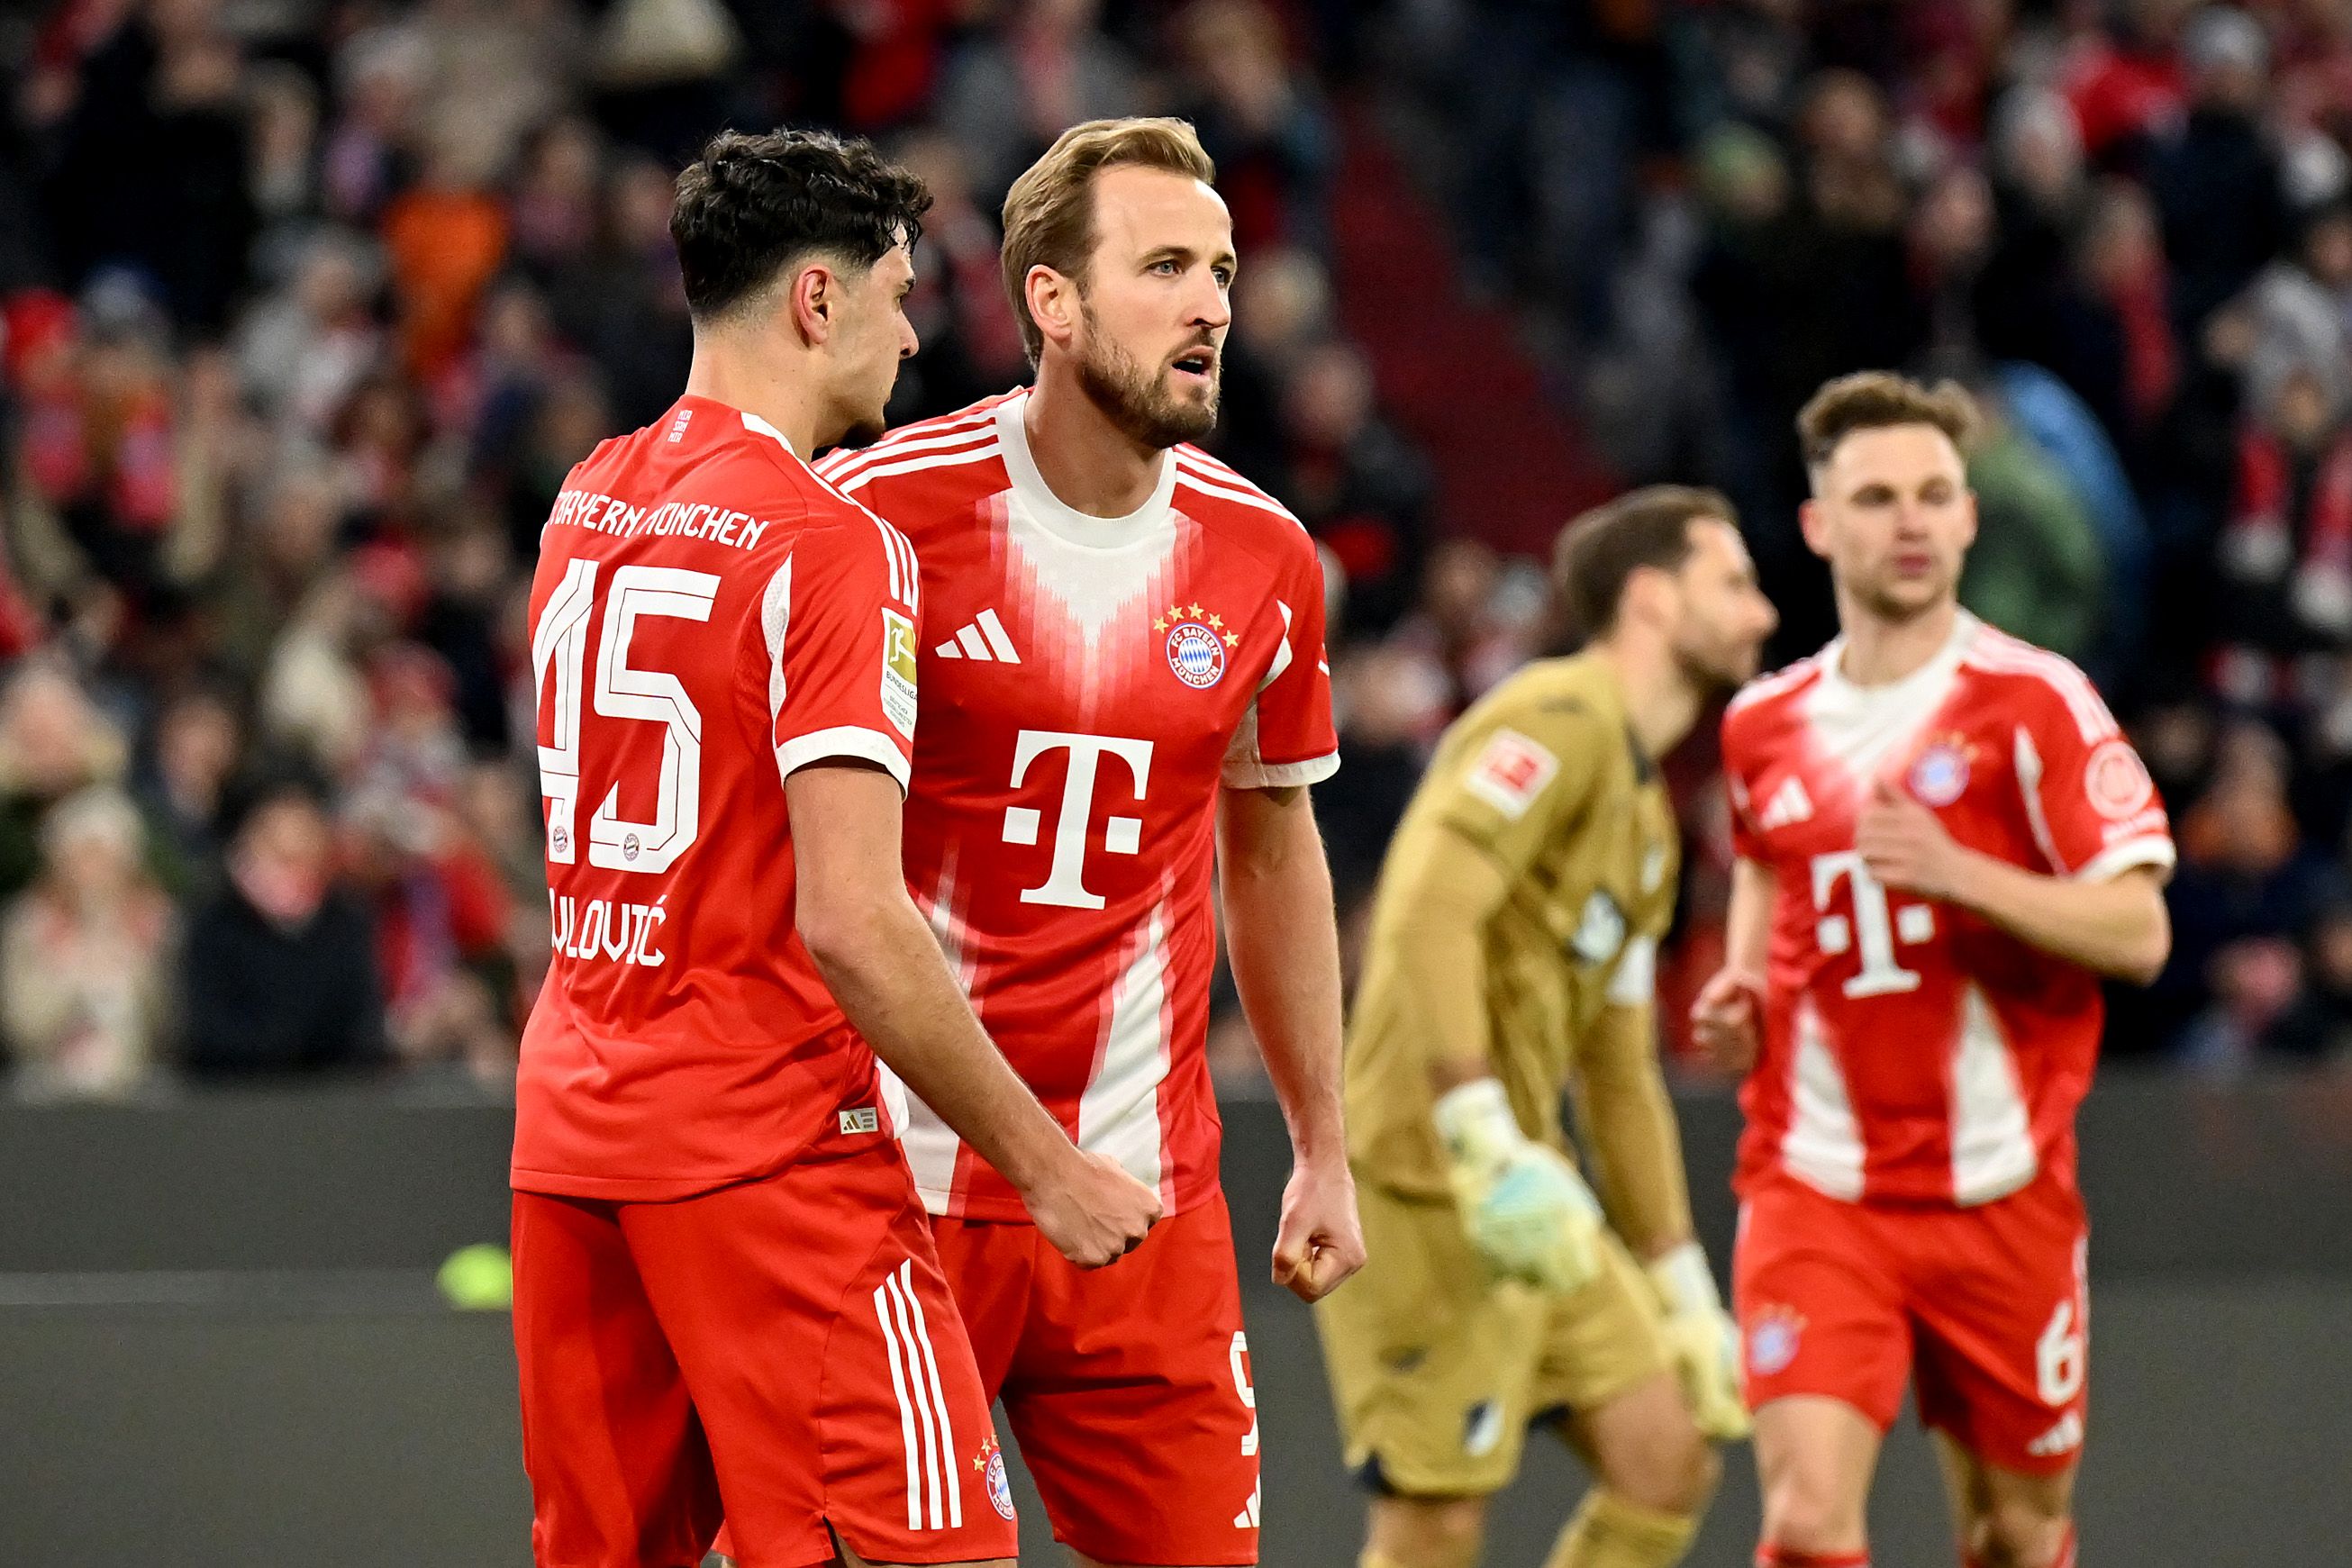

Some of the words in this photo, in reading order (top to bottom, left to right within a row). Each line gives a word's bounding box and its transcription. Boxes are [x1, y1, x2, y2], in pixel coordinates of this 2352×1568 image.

[555, 490, 647, 538] BAYERN
[1171, 633, 1183, 648] FC
[1183, 628, 1220, 656] BAYERN
[531, 557, 722, 874] 45
[549, 887, 667, 967] VLOVIĆ
[2035, 1301, 2084, 1407] 6
